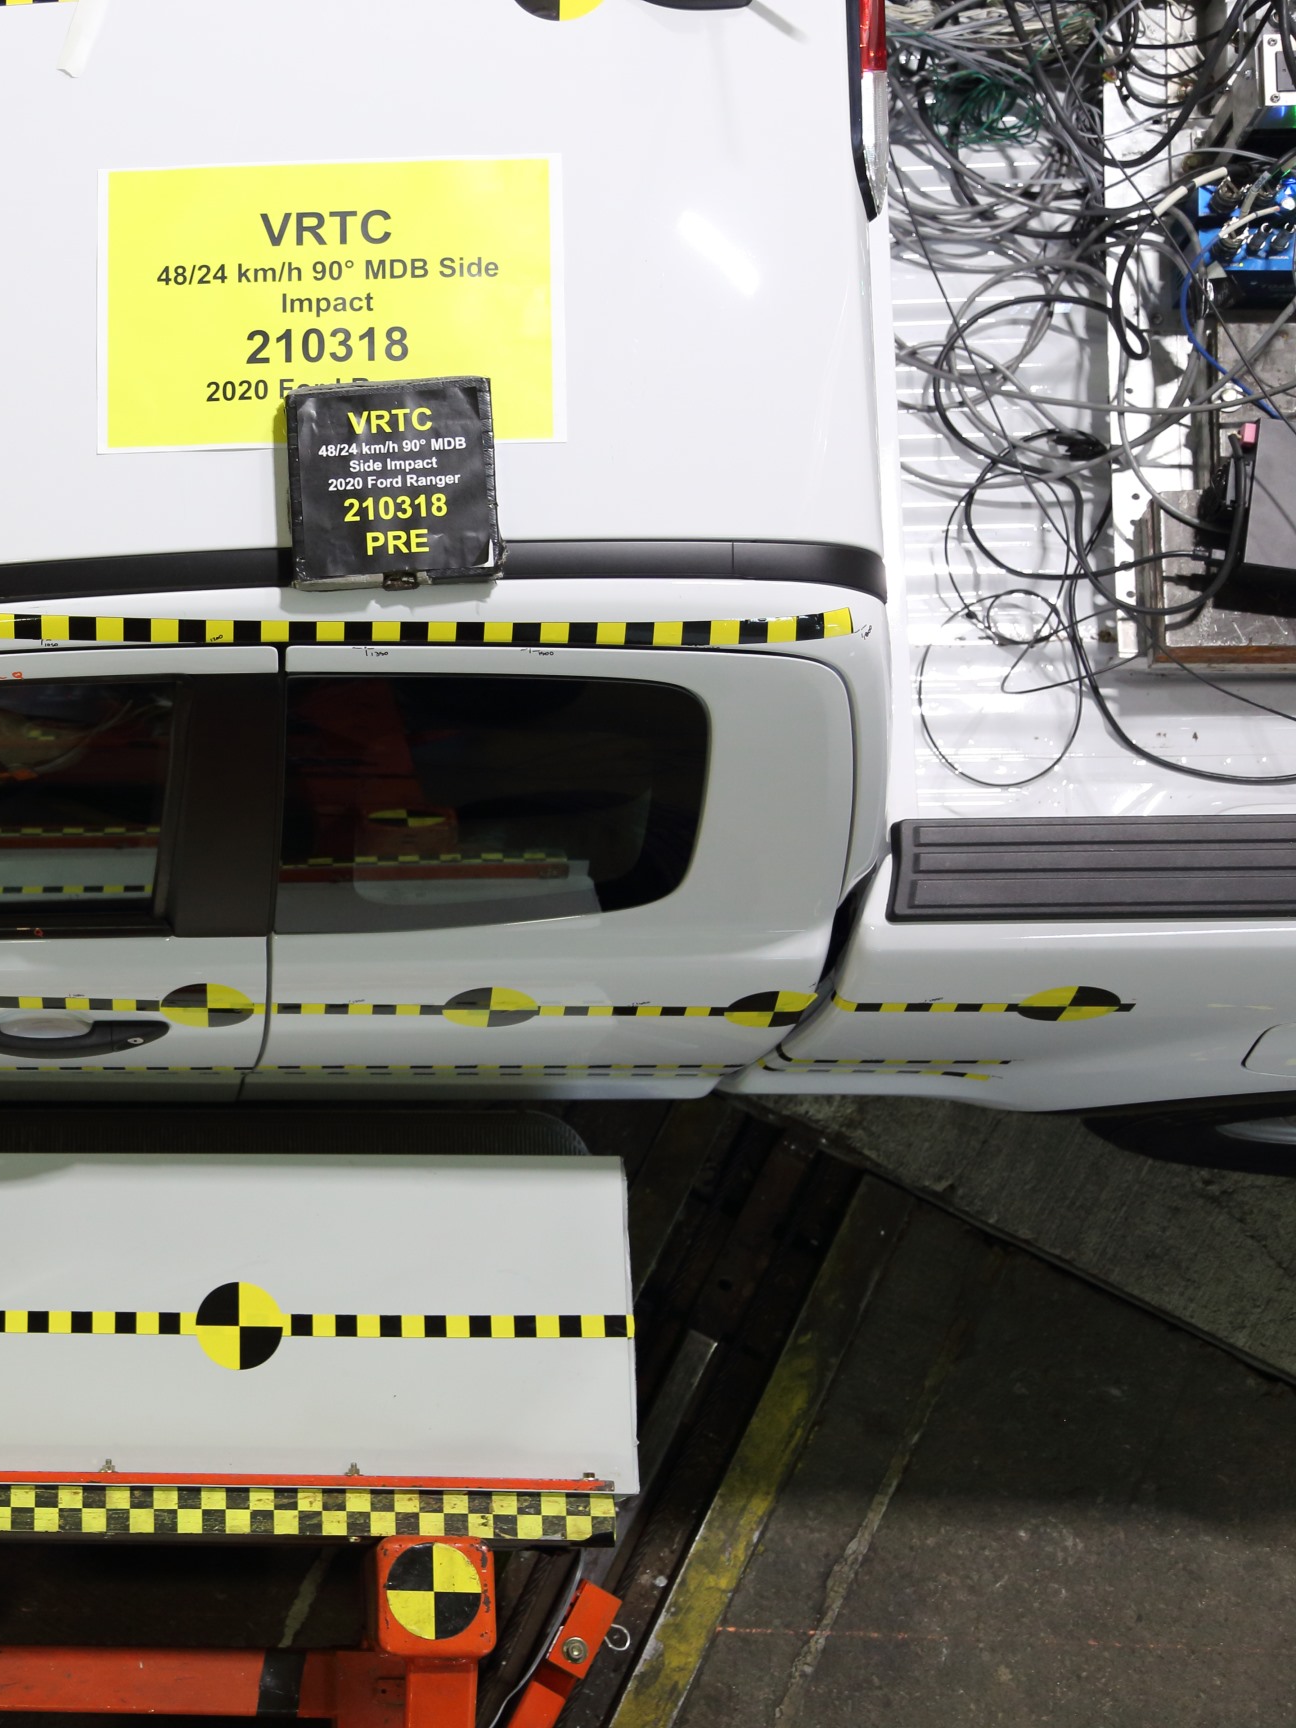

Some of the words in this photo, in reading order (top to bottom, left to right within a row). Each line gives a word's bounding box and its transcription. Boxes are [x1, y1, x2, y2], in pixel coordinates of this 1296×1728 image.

[261, 210, 391, 246] VRTC
[157, 264, 227, 285] 48/24
[238, 262, 301, 282] km/h
[313, 261, 353, 280] 90°
[366, 259, 428, 279] MDB
[440, 258, 497, 277] Side
[283, 293, 373, 317] Impact
[247, 327, 408, 364] 210318
[207, 380, 268, 401] 2020
[348, 408, 432, 434] VRTC
[319, 443, 359, 457] 48/24
[362, 441, 398, 454] km/h
[402, 439, 426, 452] 90°
[431, 437, 466, 450] MDB
[350, 459, 382, 472] Side
[387, 457, 437, 472] Impact
[329, 477, 362, 491] 2020
[368, 475, 402, 488] Ford
[407, 474, 461, 487] Ranger
[344, 493, 447, 521] 210318
[367, 529, 429, 555] PRE
